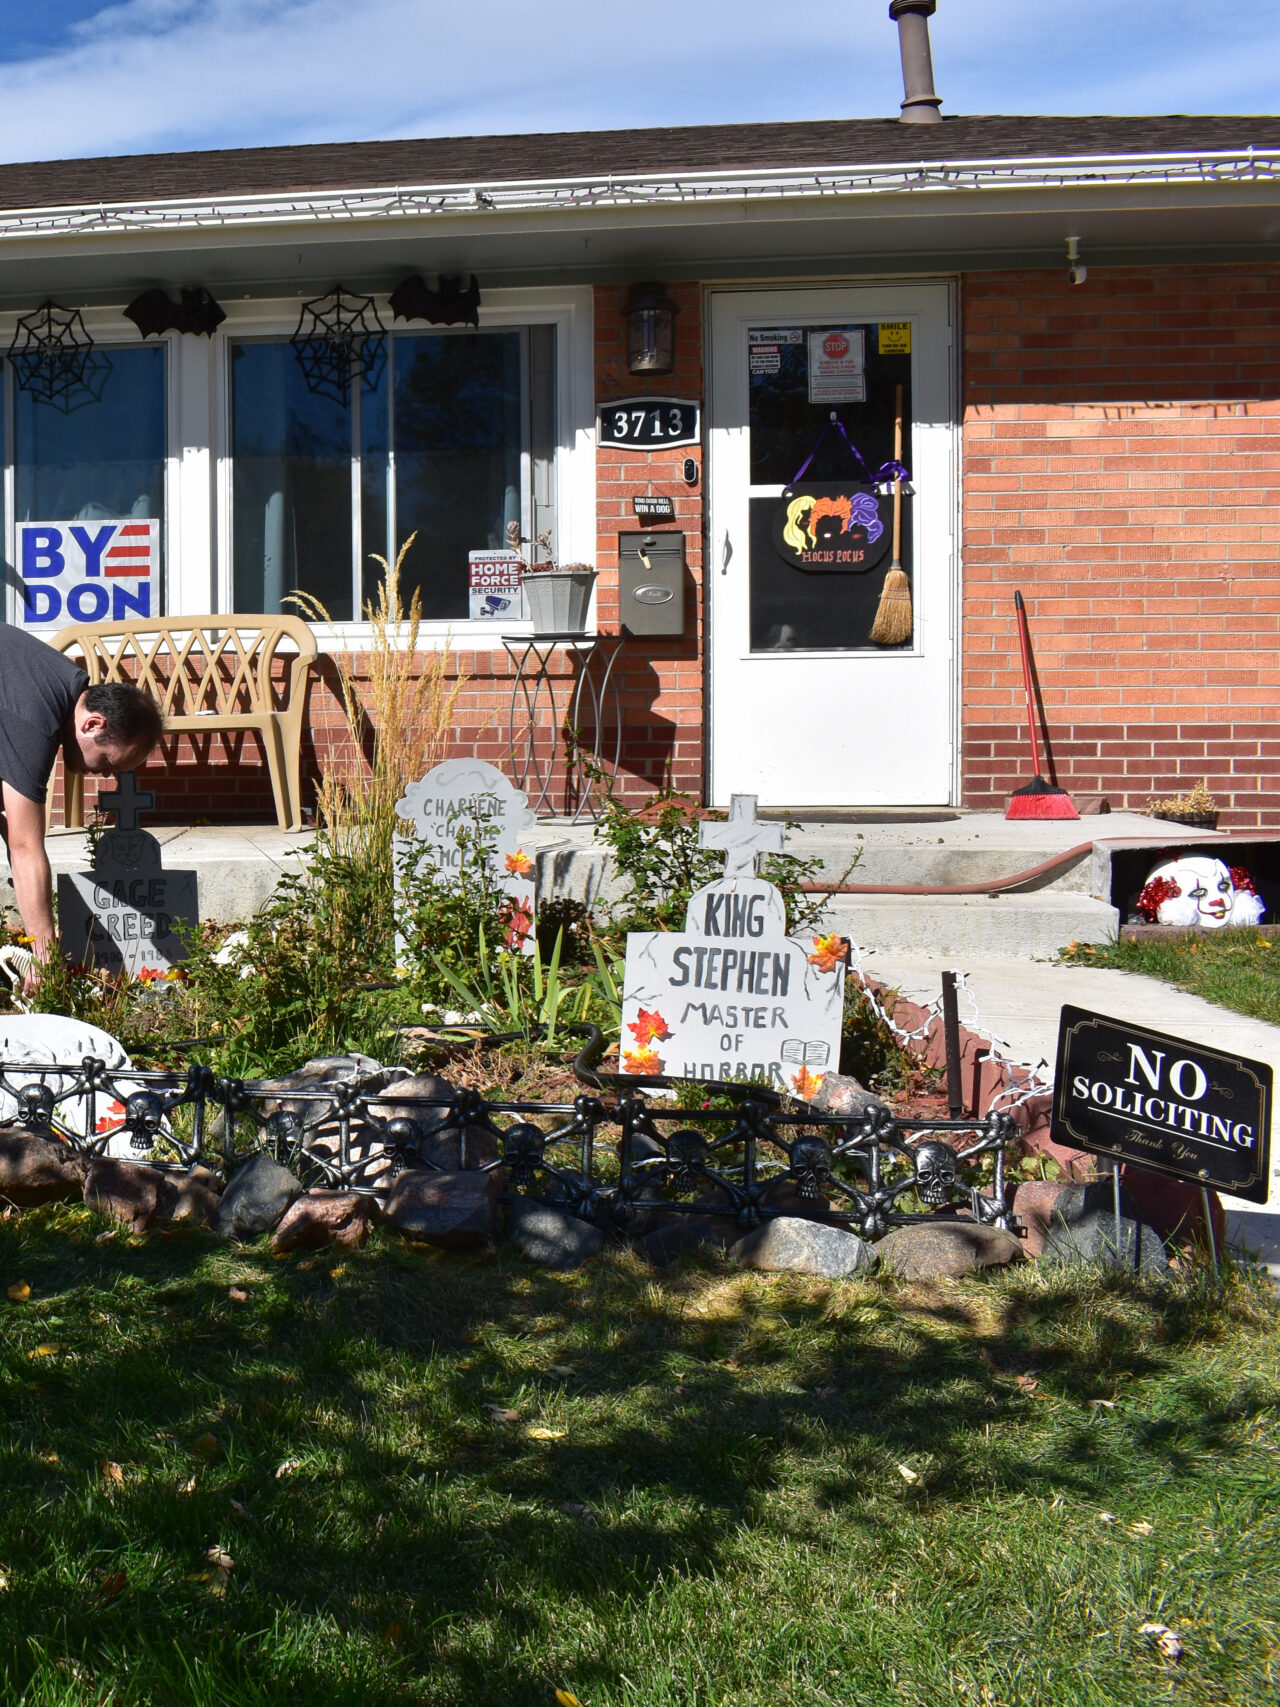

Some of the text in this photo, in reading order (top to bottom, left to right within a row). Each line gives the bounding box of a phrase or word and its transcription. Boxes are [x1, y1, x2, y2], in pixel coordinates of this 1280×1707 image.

[760, 333, 788, 342] Smoking
[880, 322, 908, 330] SMILE
[825, 341, 847, 351] STOP
[613, 409, 683, 438] 3713
[634, 504, 670, 513] WIN A DOG
[22, 525, 150, 578] BYE
[802, 550, 865, 563] HOCUS POCUS
[471, 563, 518, 575] HOME
[471, 575, 519, 586] FORCE
[24, 582, 150, 623] DON
[471, 586, 519, 594] SECURITY
[439, 848, 496, 868] MCGE
[94, 879, 166, 909] GAGE
[85, 912, 171, 941] CREED
[704, 893, 765, 938] KING
[669, 946, 790, 996] STEPHEN
[681, 1002, 789, 1029] MASTER
[720, 1033, 744, 1052] OF
[1124, 1042, 1208, 1101] NO
[1072, 1075, 1255, 1148] SOLICITING
[1125, 1128, 1200, 1160] Thank You
